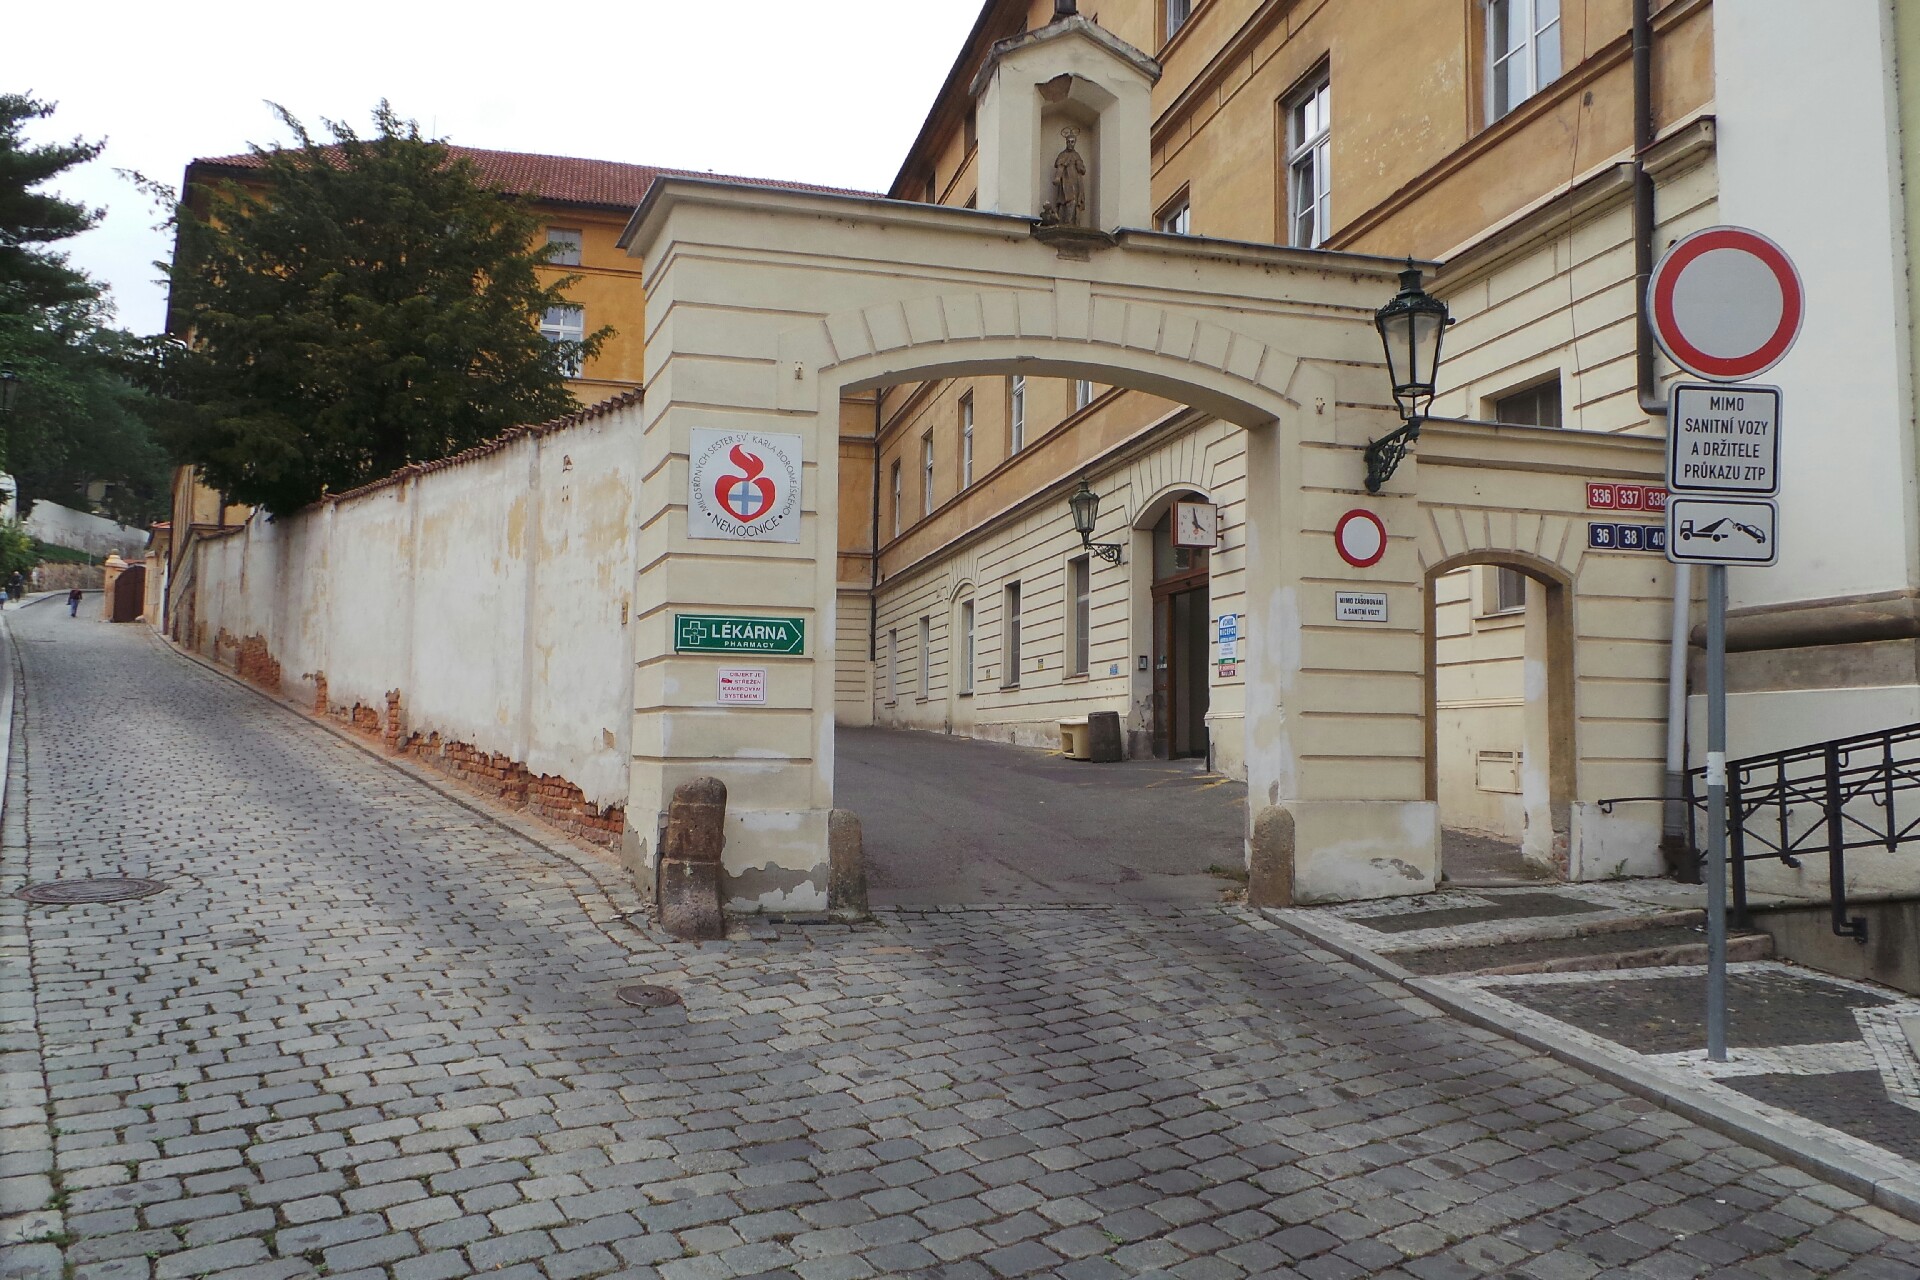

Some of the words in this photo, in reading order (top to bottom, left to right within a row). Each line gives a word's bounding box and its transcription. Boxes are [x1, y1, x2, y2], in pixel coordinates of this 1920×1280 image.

[1710, 396, 1744, 411] MIMO
[1685, 416, 1734, 434] SANITNÍ
[1738, 420, 1768, 436] VOZY
[708, 435, 734, 455] SESTER
[752, 435, 777, 453] KARLA
[1691, 441, 1699, 456] A
[1703, 438, 1760, 459] DRŽITELE
[1684, 461, 1740, 480] PRŮKAZU
[1744, 466, 1766, 481] ZTP
[1592, 488, 1611, 504] 336
[1620, 490, 1639, 505] 337
[1648, 492, 1666, 506] 338
[711, 514, 780, 537] NEMOCNICE
[1596, 528, 1610, 544] 36
[1624, 529, 1637, 545] 38
[1652, 531, 1665, 546] 40
[1339, 597, 1354, 605] MIMO
[711, 621, 788, 641] LÉKÁRNA
[724, 640, 774, 649] PHARMACY
